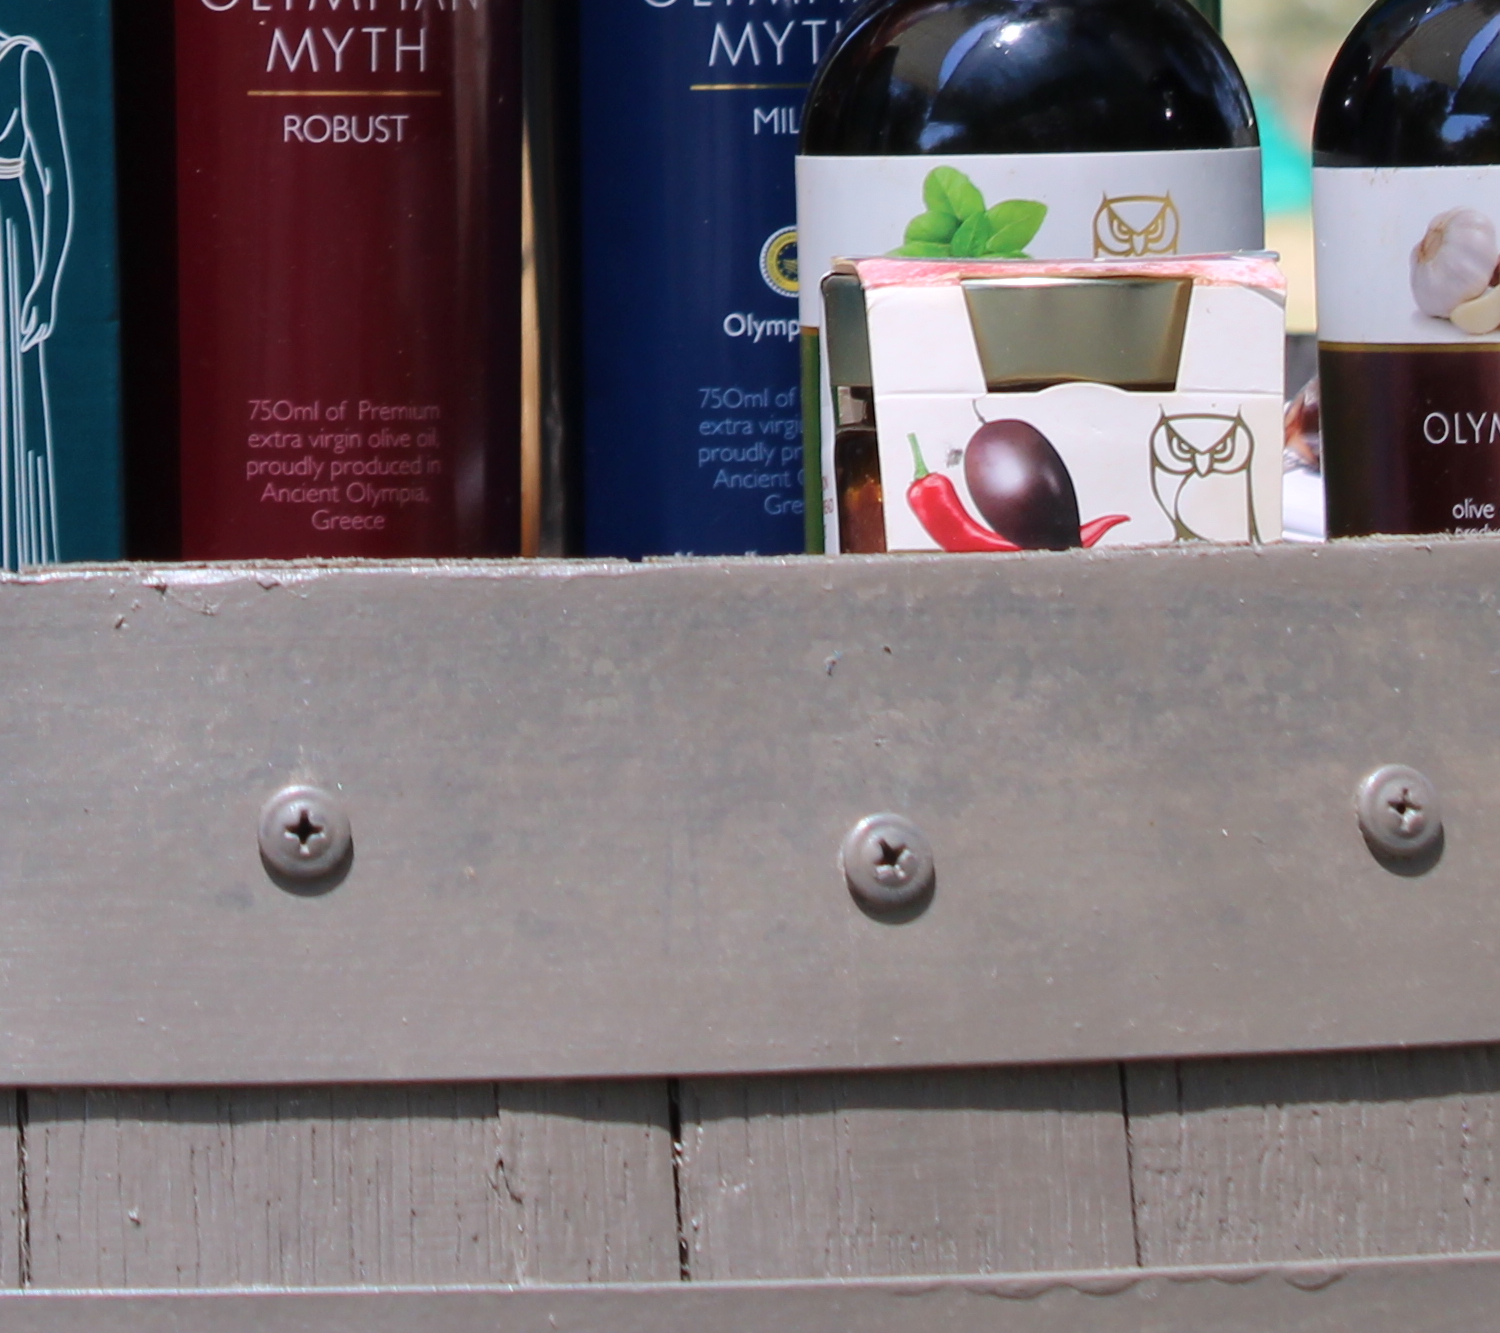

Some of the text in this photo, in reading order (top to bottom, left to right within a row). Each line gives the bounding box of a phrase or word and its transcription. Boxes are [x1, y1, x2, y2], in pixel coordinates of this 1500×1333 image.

[265, 26, 428, 75] MYTH
[708, 18, 842, 67] MYT
[283, 114, 409, 144] ROBUST
[754, 106, 800, 135] MIL
[723, 312, 801, 343] Olymp
[775, 387, 797, 408] of
[325, 400, 348, 422] of
[359, 400, 441, 422] Premium
[698, 414, 803, 440] extra virgi
[248, 428, 302, 449] extra
[308, 427, 362, 454] virgin
[367, 427, 410, 449] olive
[697, 441, 776, 467] proudly
[246, 454, 441, 481] proudly produced in
[713, 470, 792, 489] Ancient
[261, 481, 339, 503] Ancient
[764, 493, 805, 515] Gre
[311, 510, 386, 531] Greece
[1452, 498, 1495, 521] olive
